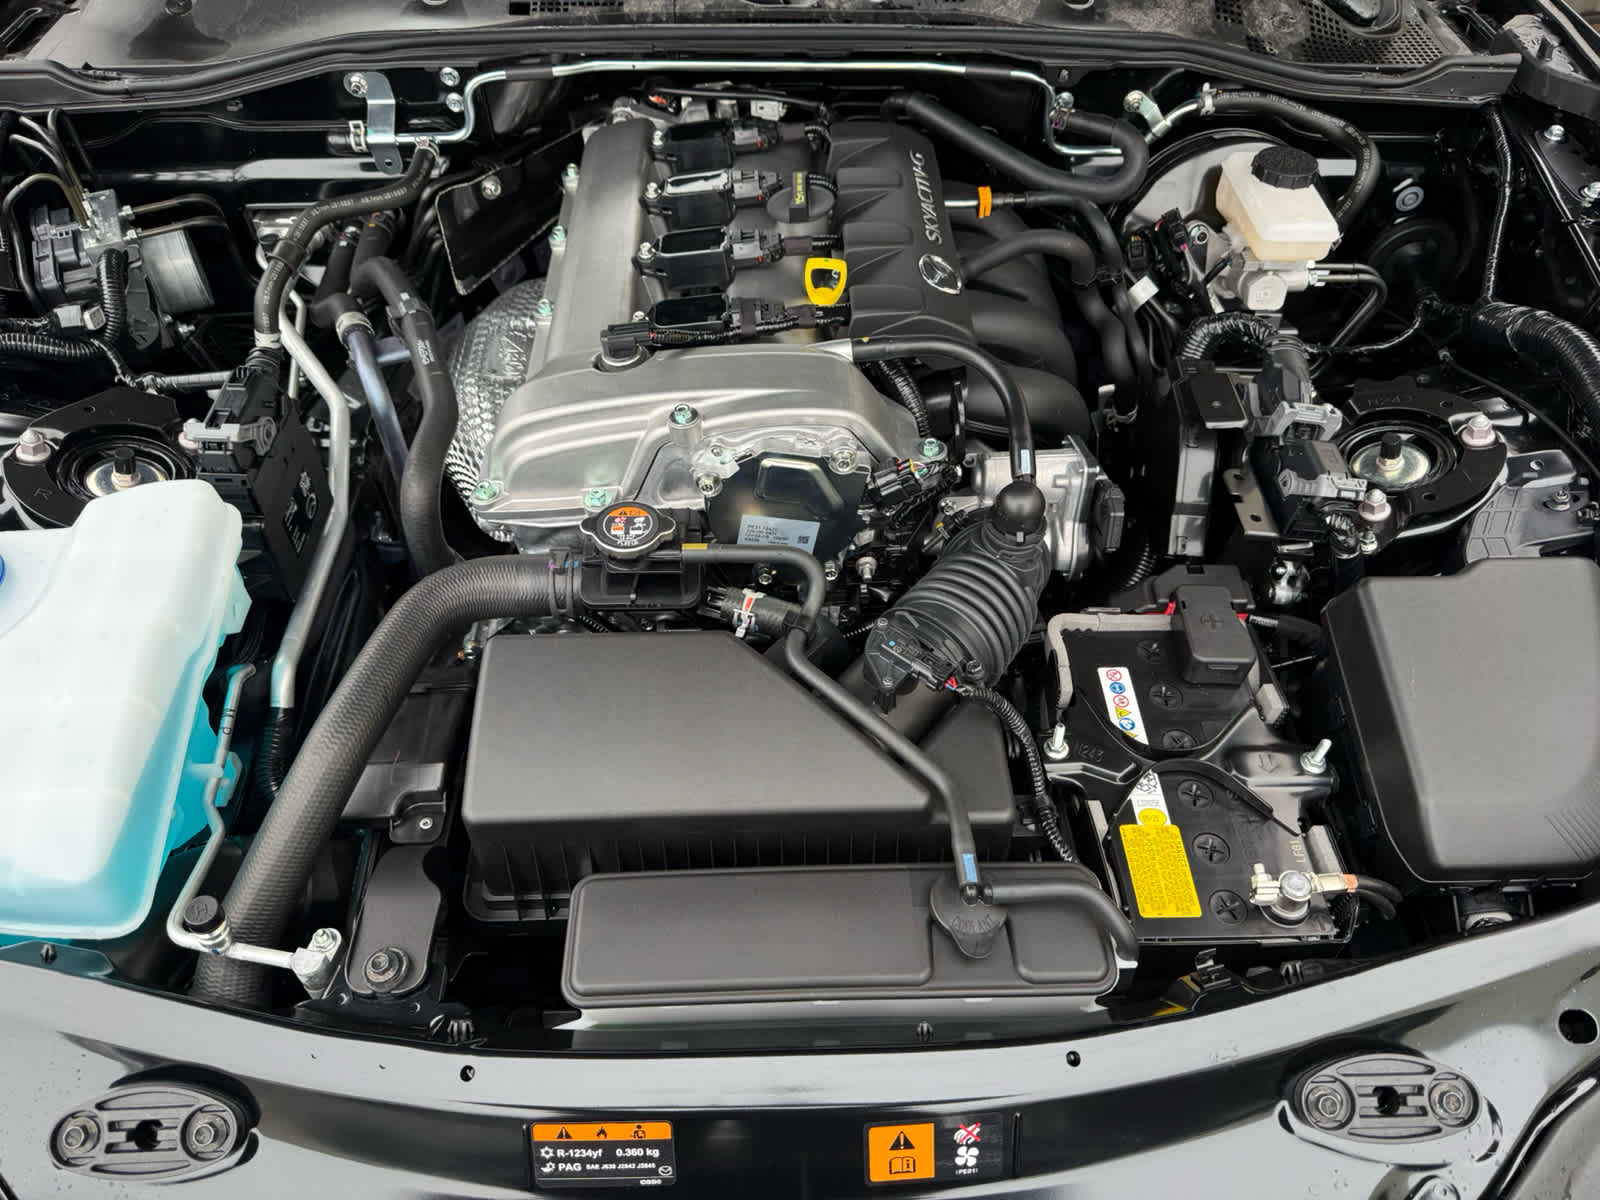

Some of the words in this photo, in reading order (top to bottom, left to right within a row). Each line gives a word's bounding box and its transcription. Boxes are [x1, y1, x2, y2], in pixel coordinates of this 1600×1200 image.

[909, 151, 944, 246] SKYACTIV-G
[557, 1147, 602, 1159] R-1234yf
[646, 1147, 660, 1158] kg
[558, 1162, 582, 1172] PAG
